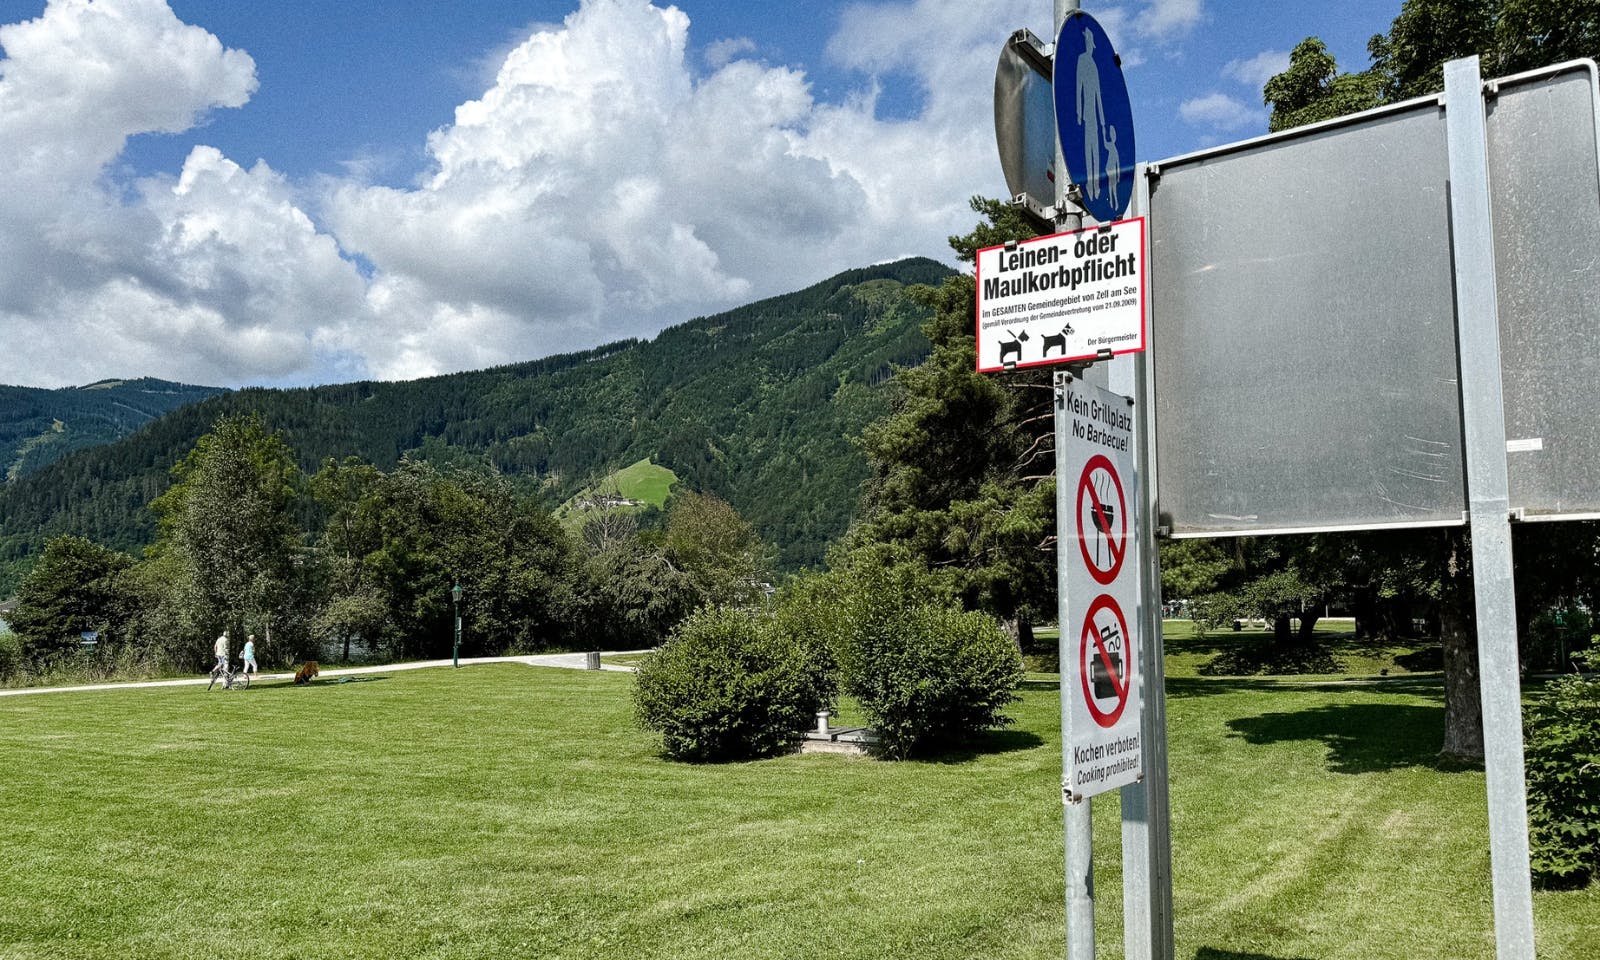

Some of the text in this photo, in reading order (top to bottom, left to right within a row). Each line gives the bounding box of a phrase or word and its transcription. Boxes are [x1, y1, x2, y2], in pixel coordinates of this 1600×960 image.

[999, 233, 1119, 273] Leinen- oder
[984, 253, 1135, 300] Maulkorbpflicht
[992, 304, 1026, 317] GESAMTEN
[1028, 295, 1080, 311] Gemeindegebiet
[1082, 292, 1094, 302] von
[1097, 289, 1109, 300] Zell
[1111, 289, 1122, 298] am
[1124, 286, 1137, 295] See
[1001, 314, 1029, 327] Verordnung
[1030, 313, 1038, 321] der
[1088, 332, 1137, 346] Der Bürgermeister
[1067, 390, 1131, 432] Kein Grillplatz
[1073, 419, 1128, 452] No Barbecue!
[1075, 732, 1139, 765] Kochen verboten!
[1078, 754, 1139, 785] Cooking prohibited!
